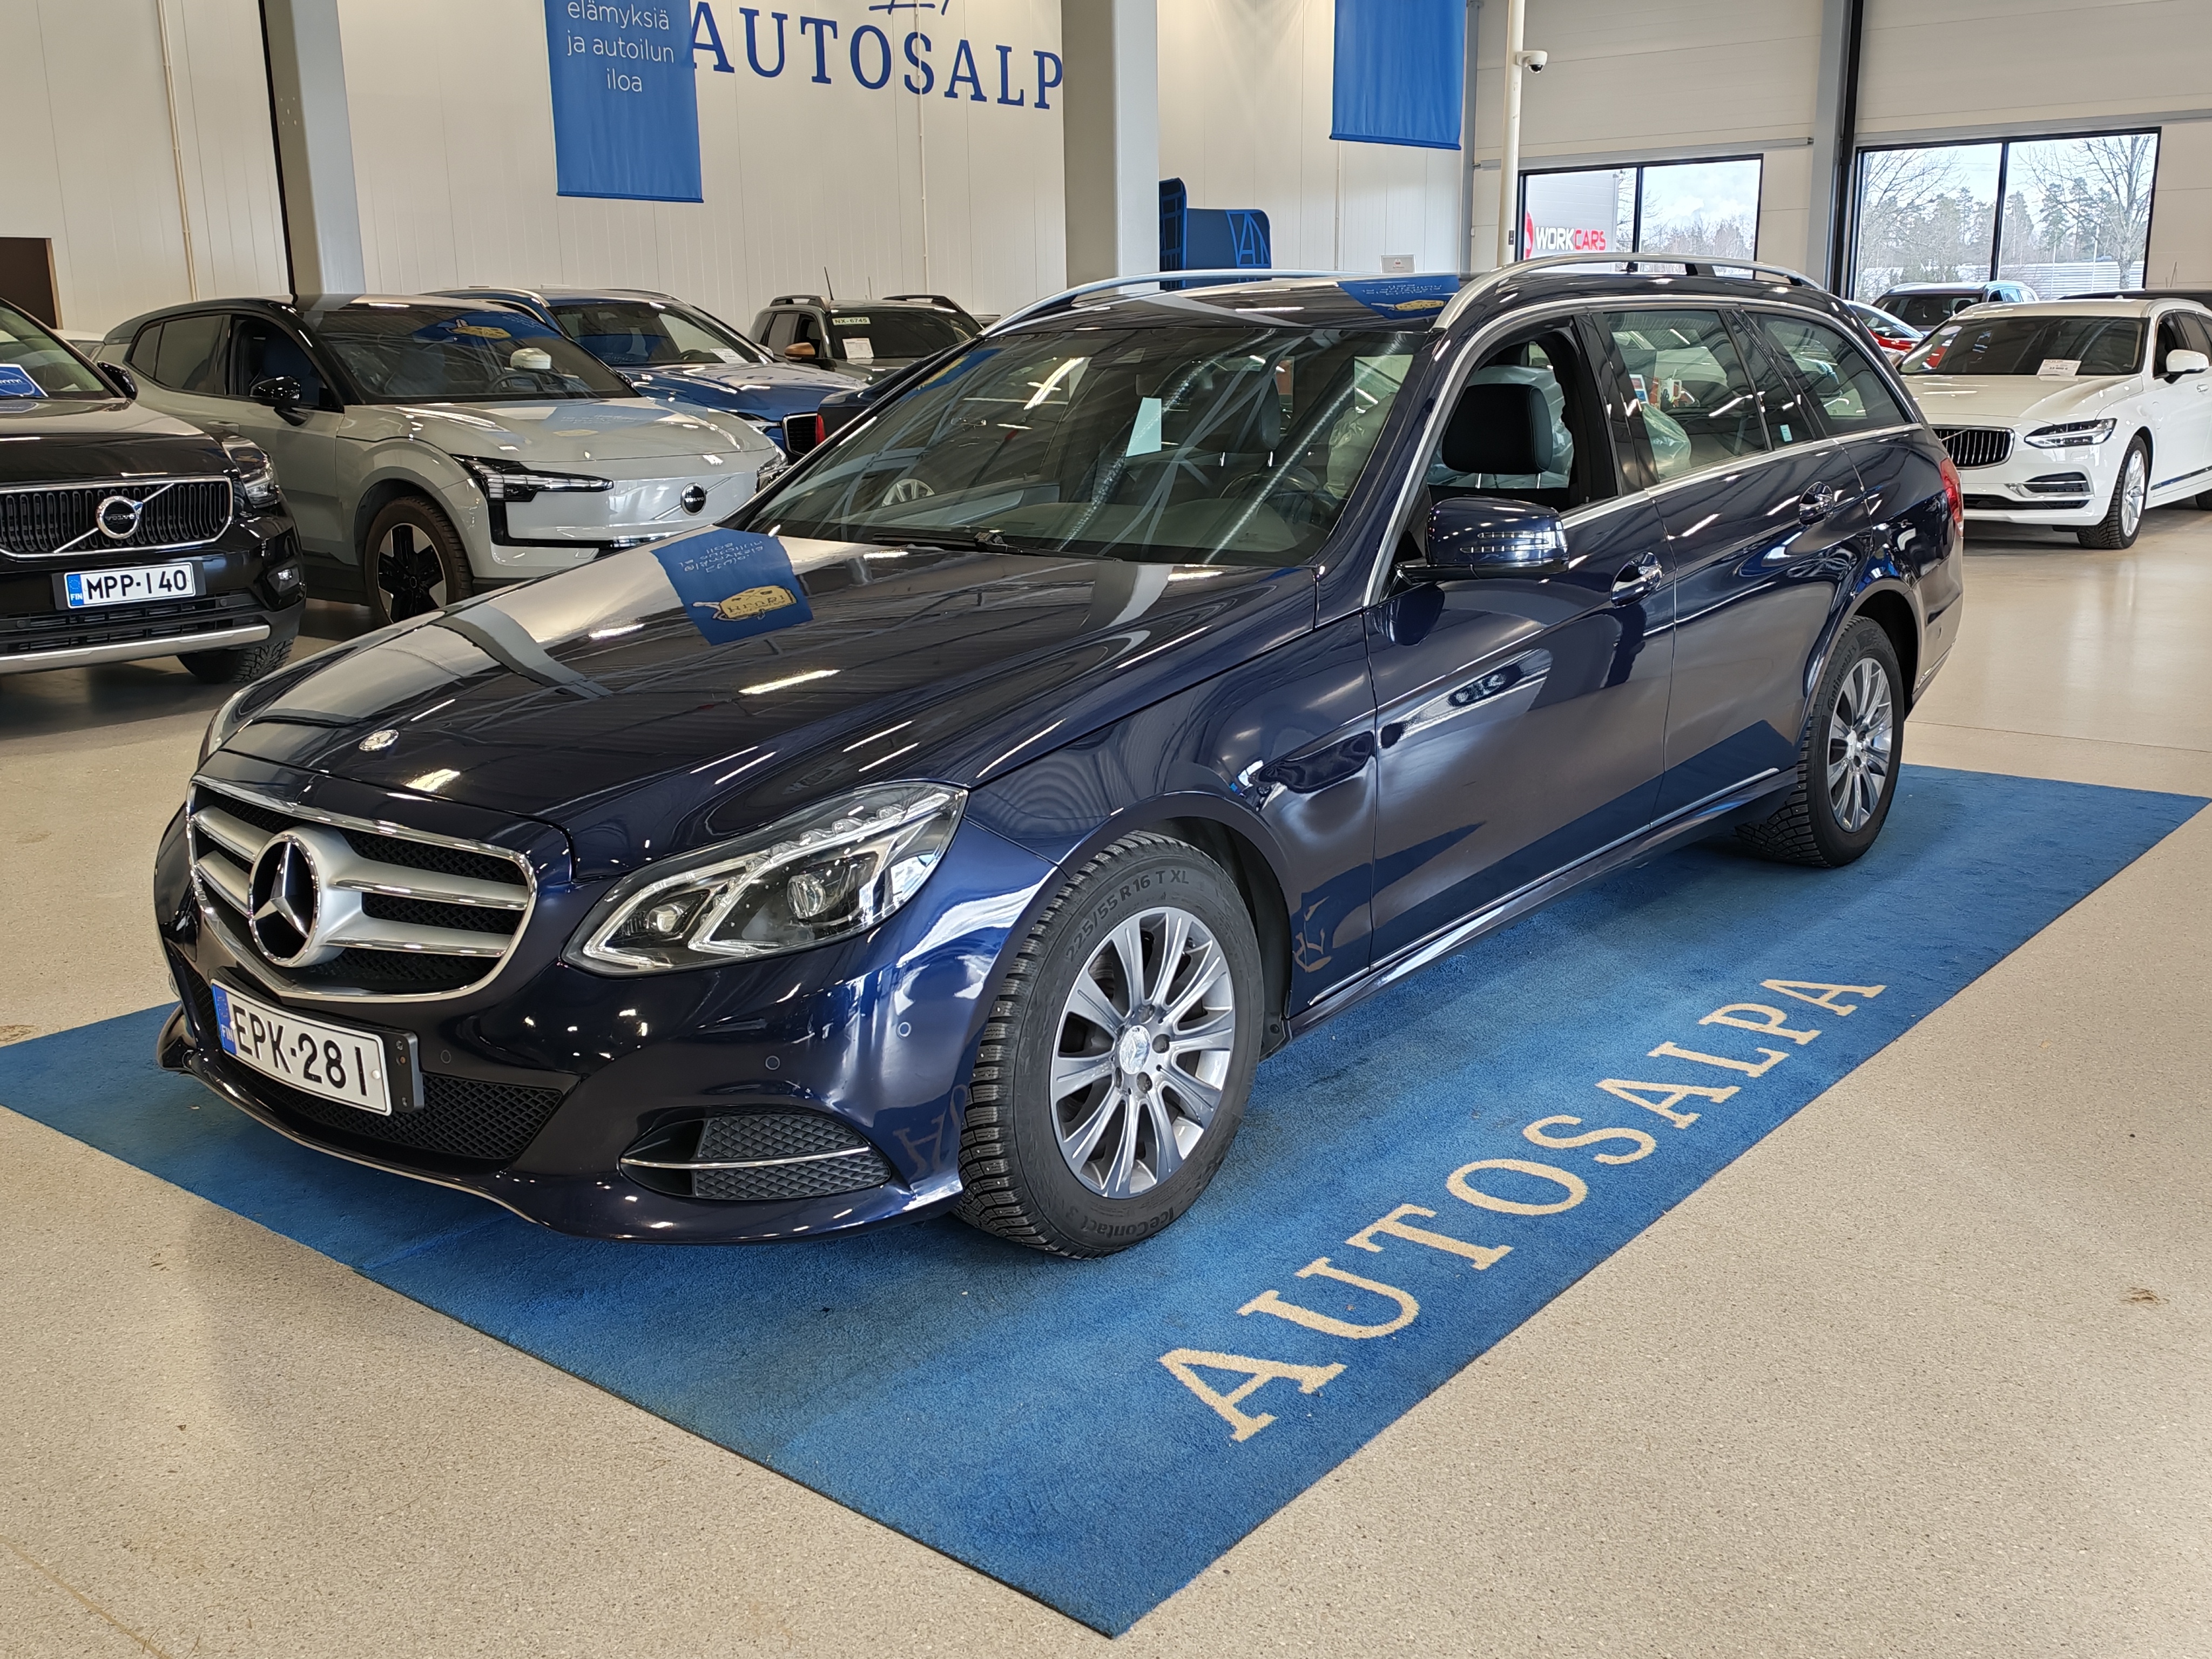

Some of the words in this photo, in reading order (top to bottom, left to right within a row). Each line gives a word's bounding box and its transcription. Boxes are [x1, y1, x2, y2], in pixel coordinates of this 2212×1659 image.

[568, 0, 670, 30] elämyksiä
[567, 30, 585, 56] ja
[593, 37, 674, 63] autoilun
[606, 68, 642, 92] iloa
[86, 570, 187, 599] MPP-140
[1065, 895, 1118, 962] 225/55
[1156, 871, 1165, 884] T
[1170, 869, 1189, 884] XL
[221, 1024, 234, 1042] FIN
[232, 1004, 367, 1097] EPK-281
[1081, 1207, 1174, 1237] IceContact
[1158, 979, 1886, 1441] AUTOSALPA
